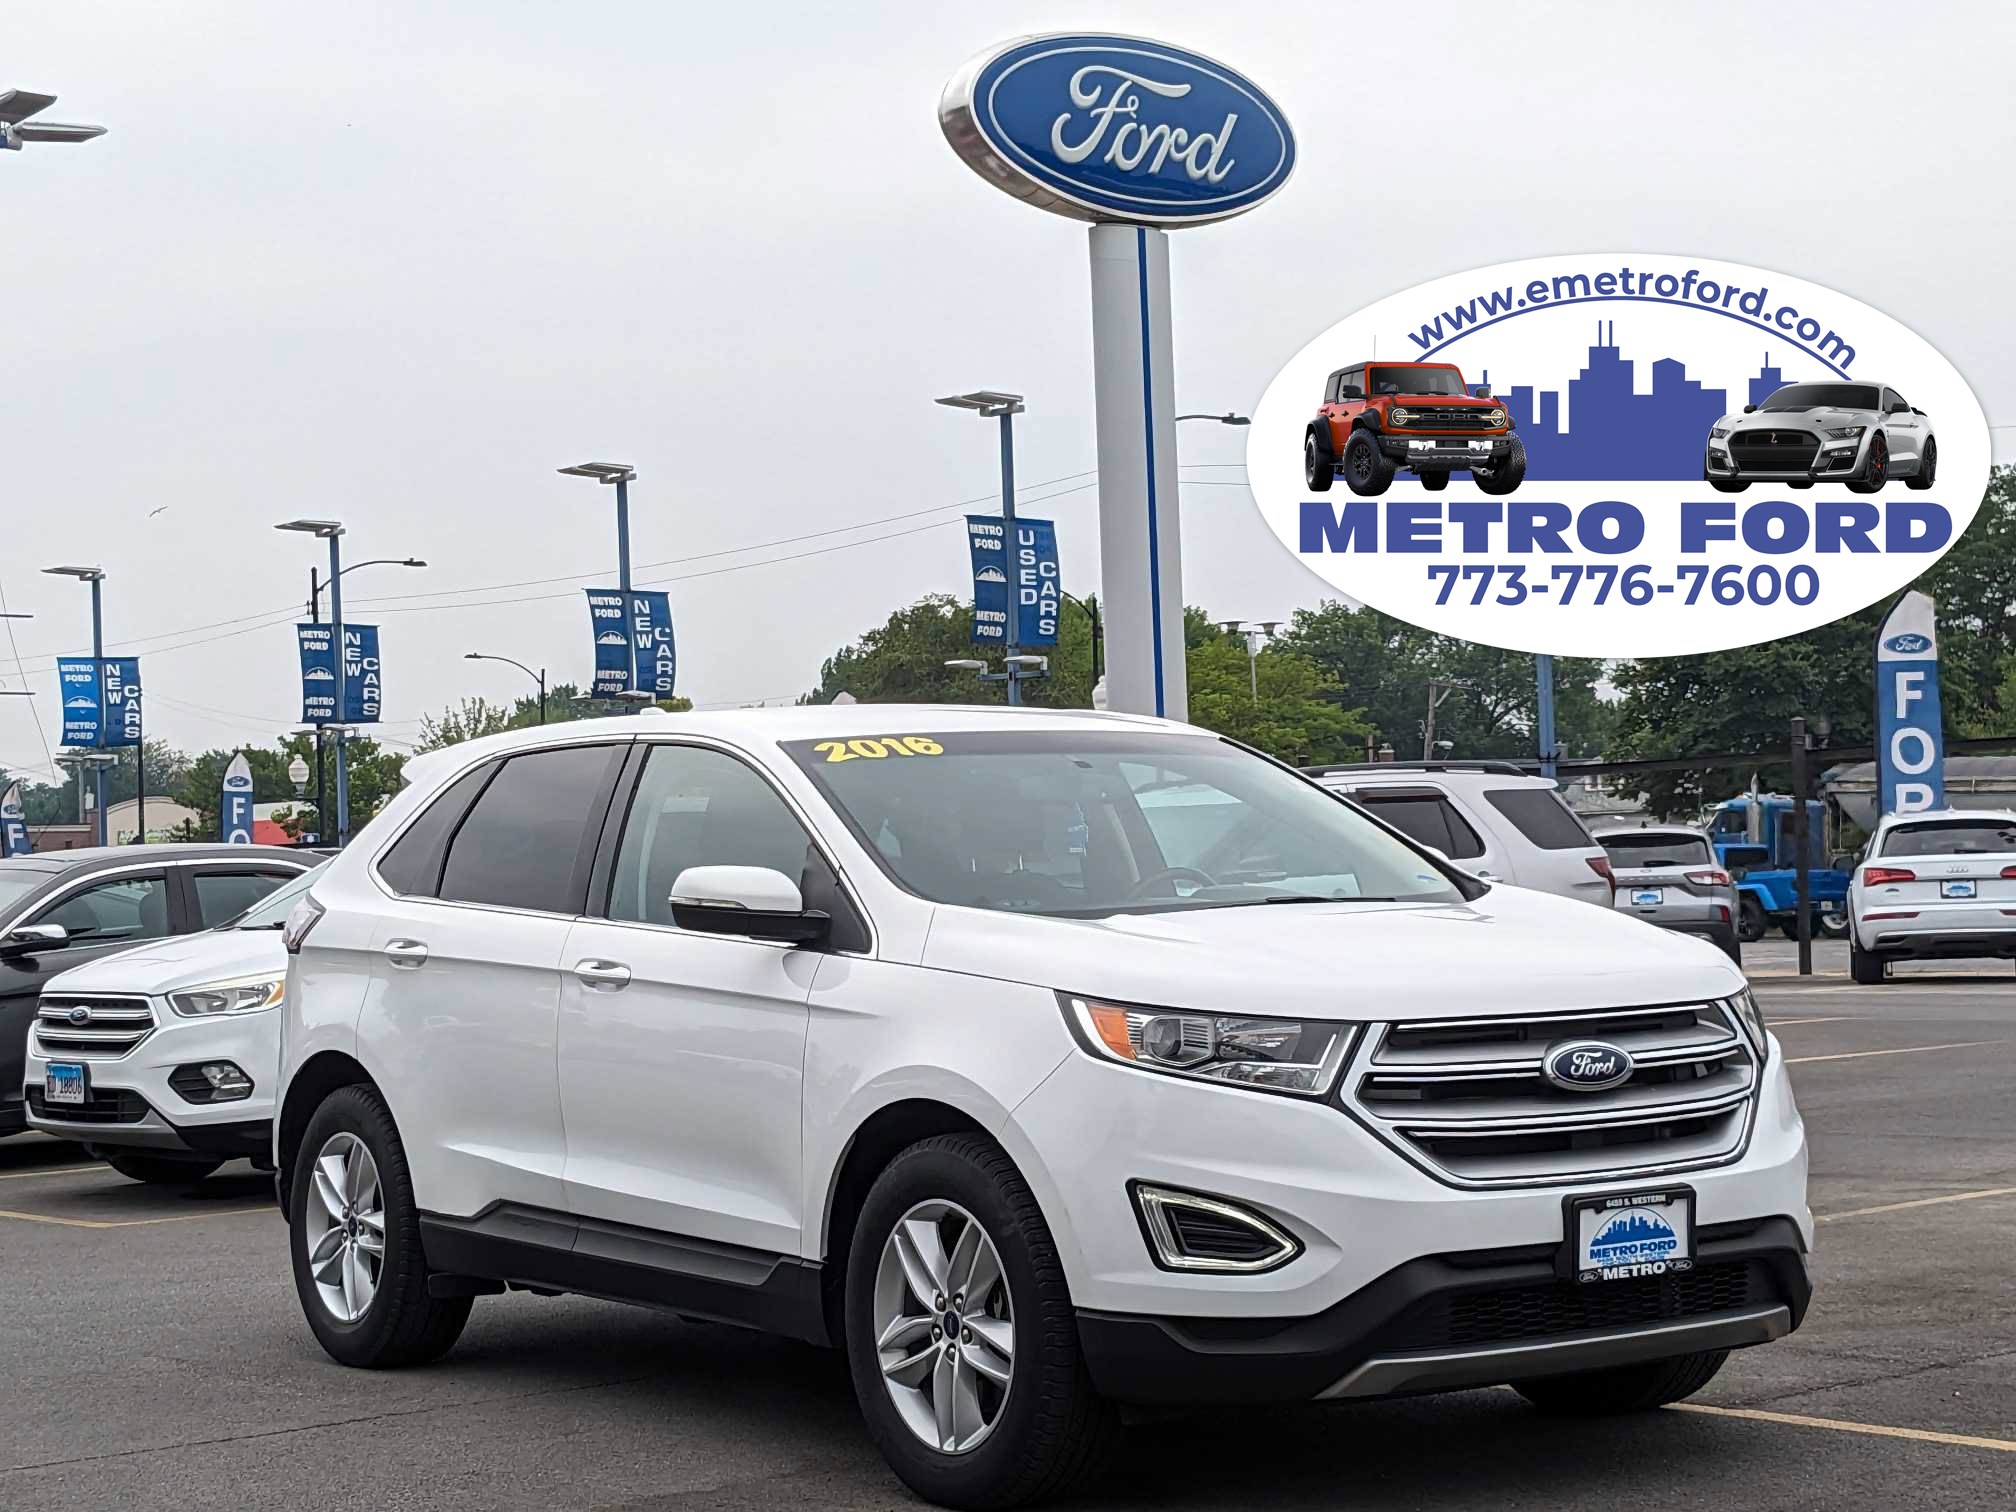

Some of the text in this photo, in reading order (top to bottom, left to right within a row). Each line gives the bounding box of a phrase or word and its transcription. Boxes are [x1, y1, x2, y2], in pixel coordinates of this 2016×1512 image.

[1052, 65, 1238, 184] Ford
[970, 524, 1003, 536] METRO
[975, 538, 1001, 550] FORD
[1018, 529, 1057, 635] USED CARS
[589, 596, 622, 606] METRO
[595, 609, 621, 618] FORD
[976, 611, 1006, 622] METRO
[299, 630, 330, 639] METRO
[977, 625, 1002, 637] FORD
[304, 641, 328, 650] FORD
[634, 600, 673, 691] NEW CARS
[345, 632, 380, 715] NEW CARS
[597, 670, 627, 679] METRO
[598, 683, 623, 692] FORD
[106, 664, 141, 738] NEW CARS
[308, 708, 332, 717] FORD
[68, 732, 94, 740] FORD
[814, 736, 944, 762] 2016
[1571, 1052, 1616, 1077] Ford
[1590, 1244, 1638, 1259] METRO
[1640, 1240, 1677, 1253] FORD
[1603, 1262, 1666, 1280] METRO
